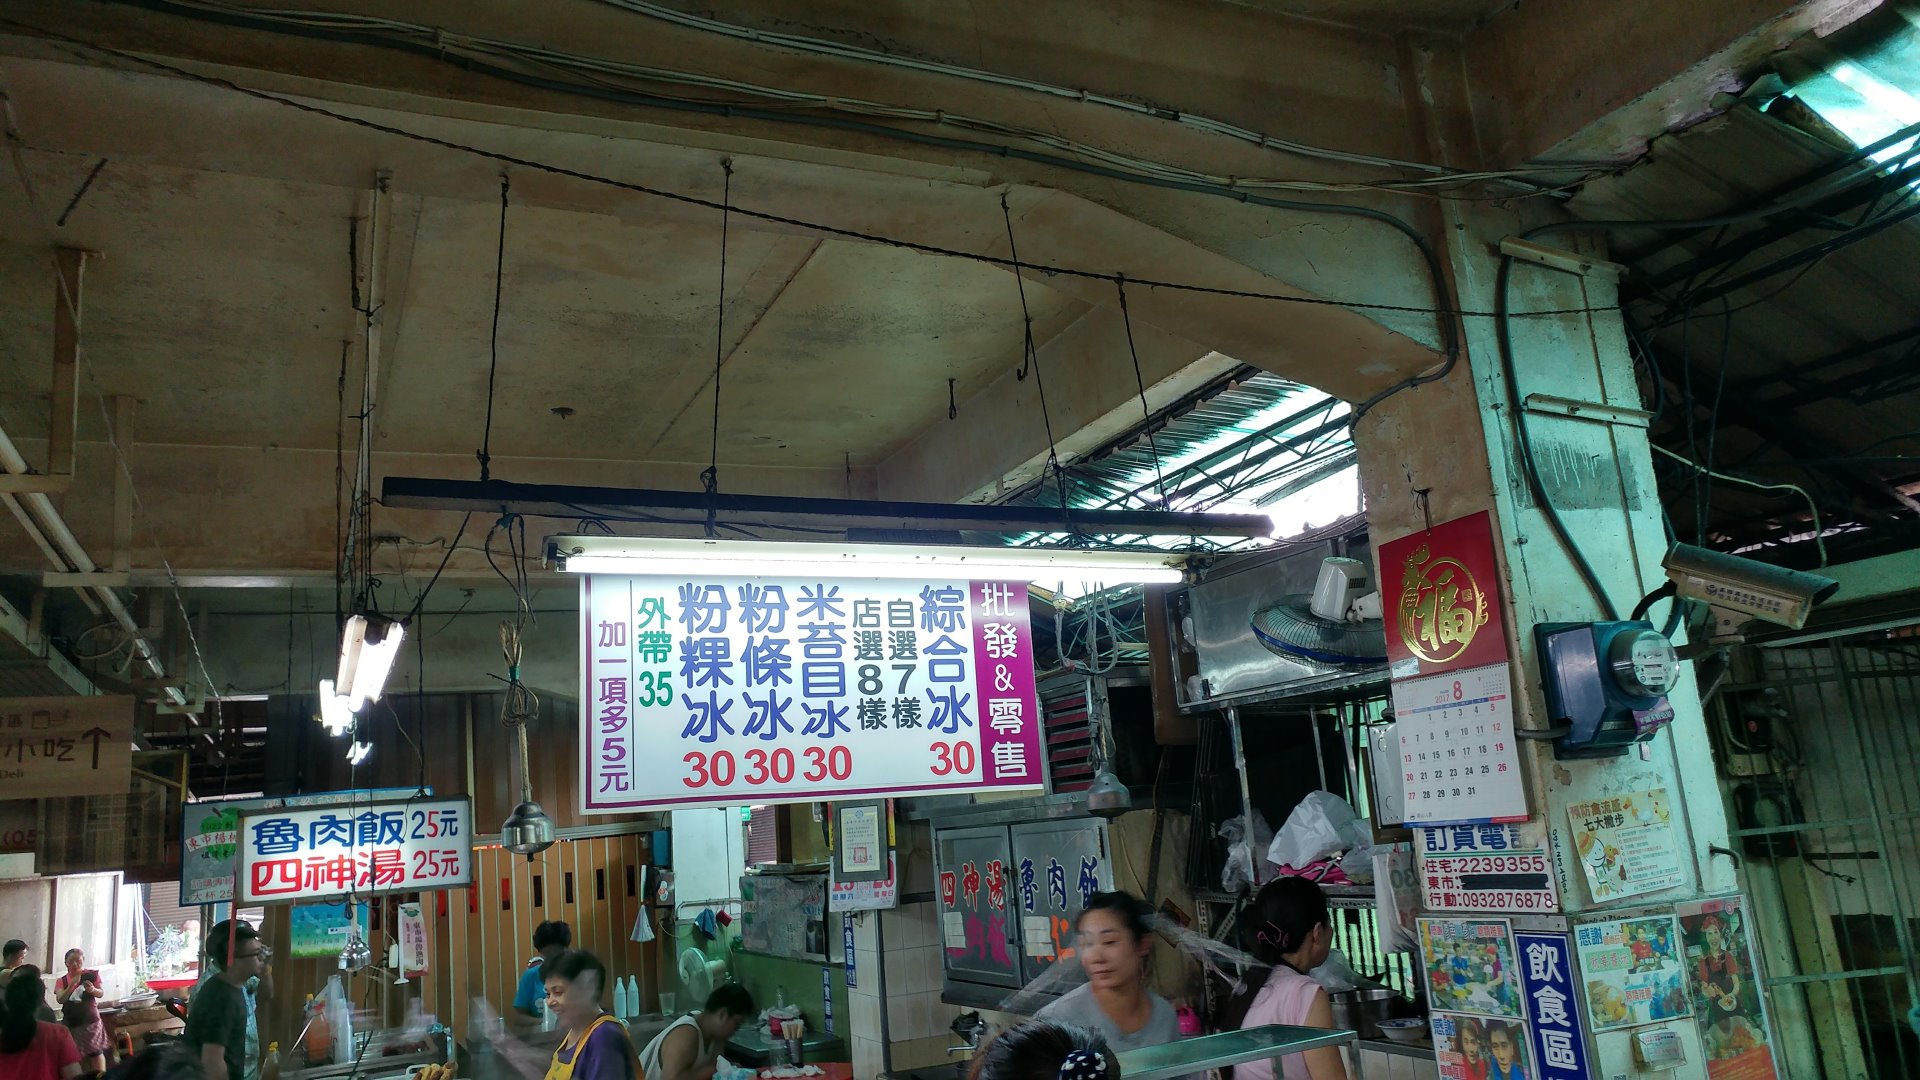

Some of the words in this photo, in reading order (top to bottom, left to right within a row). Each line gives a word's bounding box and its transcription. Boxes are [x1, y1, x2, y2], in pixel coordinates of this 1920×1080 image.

[638, 597, 671, 664] 外帶
[1419, 572, 1472, 652] 福
[678, 583, 734, 743] 粉粿冰
[739, 583, 794, 741] 粉條冰
[798, 583, 851, 739] 米苔目冰
[853, 598, 887, 731] 店選8樣
[886, 600, 922, 729] 自選7樣
[920, 584, 973, 734] 綜合冰
[981, 583, 1027, 779] 批發&零售
[599, 620, 629, 793] 加一項多5元
[639, 671, 673, 707] 35
[1435, 694, 1450, 703] 2017
[1443, 711, 1447, 719] 2
[1490, 704, 1495, 712] 5
[1453, 681, 1462, 700] 8
[4, 737, 76, 763] 小吃
[1401, 736, 1406, 744] 6
[1430, 732, 1435, 740] 8
[1444, 730, 1449, 738] 9
[1461, 728, 1469, 736] 10
[1476, 726, 1484, 734] 11
[1493, 723, 1501, 732] 12
[1404, 755, 1412, 763] 13
[1418, 753, 1426, 761] 14
[1447, 749, 1455, 757] 16
[1463, 747, 1471, 756] 17
[1478, 745, 1487, 754] 18
[1495, 743, 1504, 751] 19
[682, 750, 735, 788] 30
[744, 747, 795, 785] 30
[803, 745, 852, 782] 30
[930, 741, 975, 776] 30
[1406, 774, 1414, 782] 20
[1420, 772, 1428, 780] 21
[1435, 770, 1443, 779] 22
[1449, 768, 1458, 777] 23
[1465, 767, 1474, 775] 24
[1481, 765, 1490, 774] 25
[1498, 763, 1507, 772] 26
[1422, 790, 1431, 799] 28
[1437, 789, 1446, 798] 29
[1452, 788, 1461, 797] 30
[1467, 786, 1476, 795] 31
[251, 811, 405, 856] 魯肉飯
[411, 809, 459, 840] 25元
[251, 848, 406, 896] 四神湯
[412, 850, 460, 880] 25元
[940, 859, 1006, 911] 四神湯
[1526, 943, 1578, 1070] 飲食區
